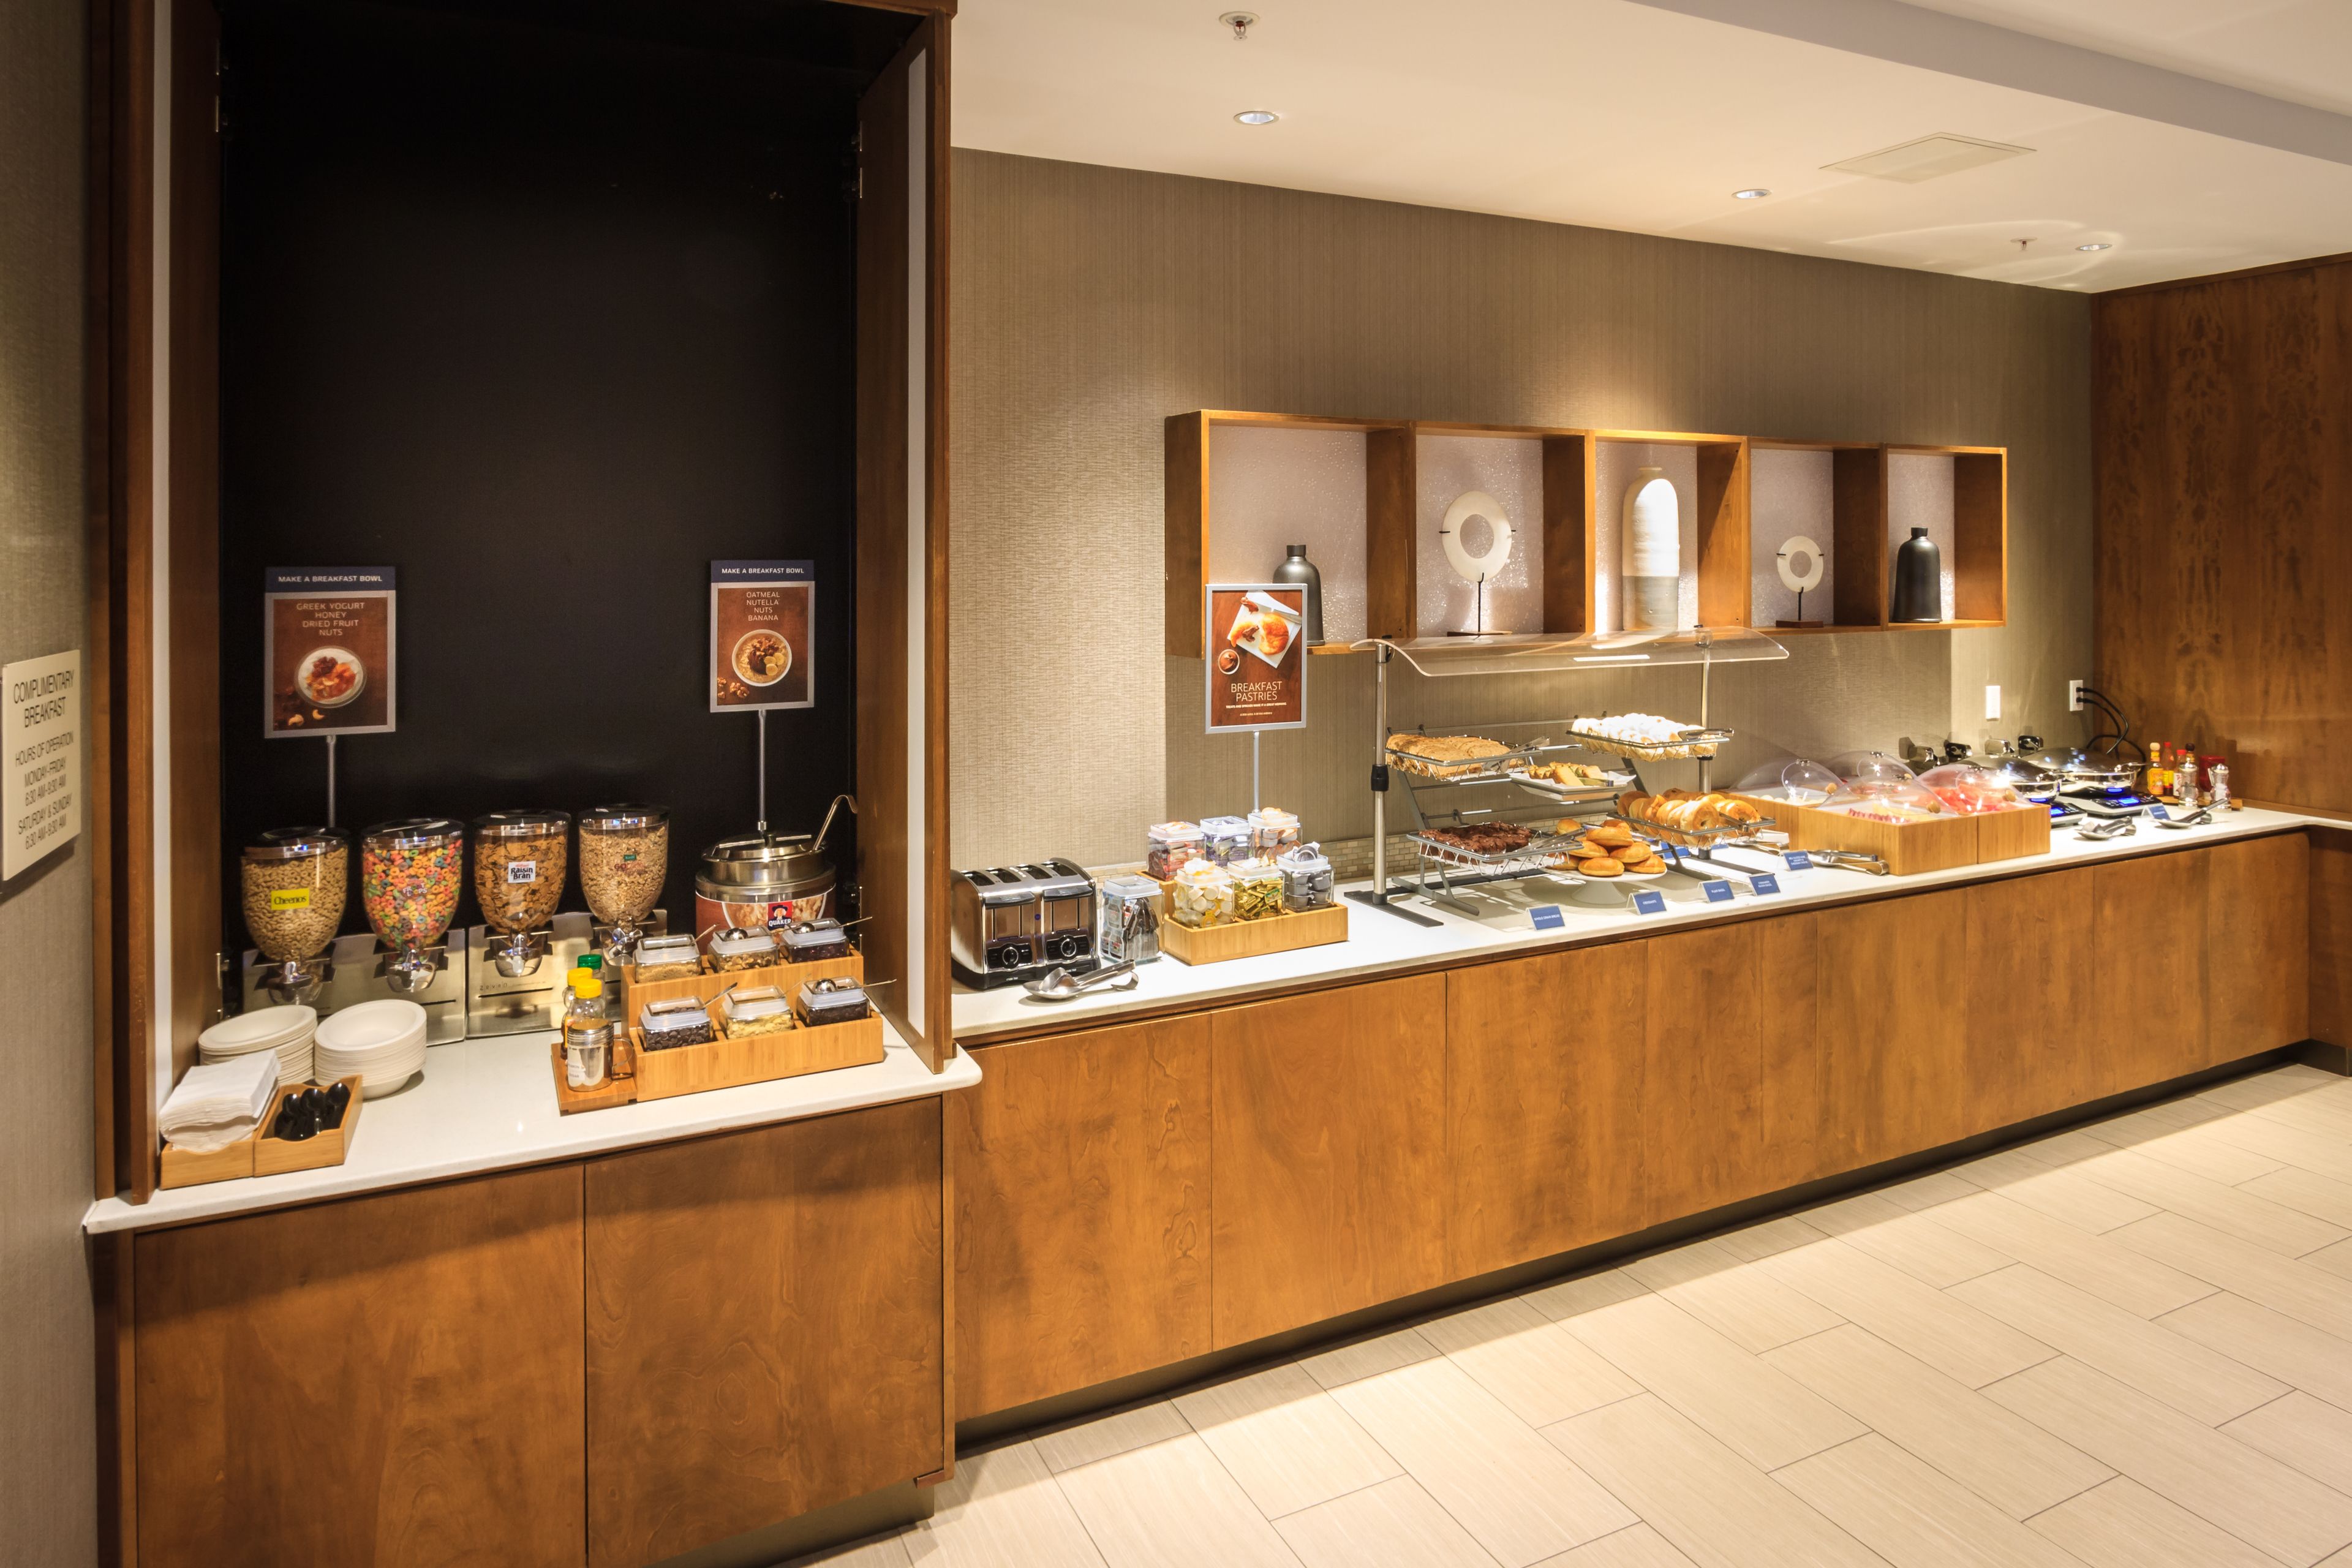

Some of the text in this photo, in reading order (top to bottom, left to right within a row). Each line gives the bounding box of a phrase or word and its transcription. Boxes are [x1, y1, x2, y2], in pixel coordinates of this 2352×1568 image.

[14, 669, 74, 704] COMPLIMENTARY
[1231, 681, 1283, 693] BREAKFAST
[1236, 691, 1278, 702] PASTRIES
[24, 696, 66, 728] BREAKFAST
[15, 730, 74, 767] HOURS OF OPERATION
[24, 755, 66, 788] MONDAY-FRIDAY
[59, 774, 66, 790] AM
[18, 791, 72, 835] SATURDAY & SUNDAY
[59, 813, 66, 829] AM
